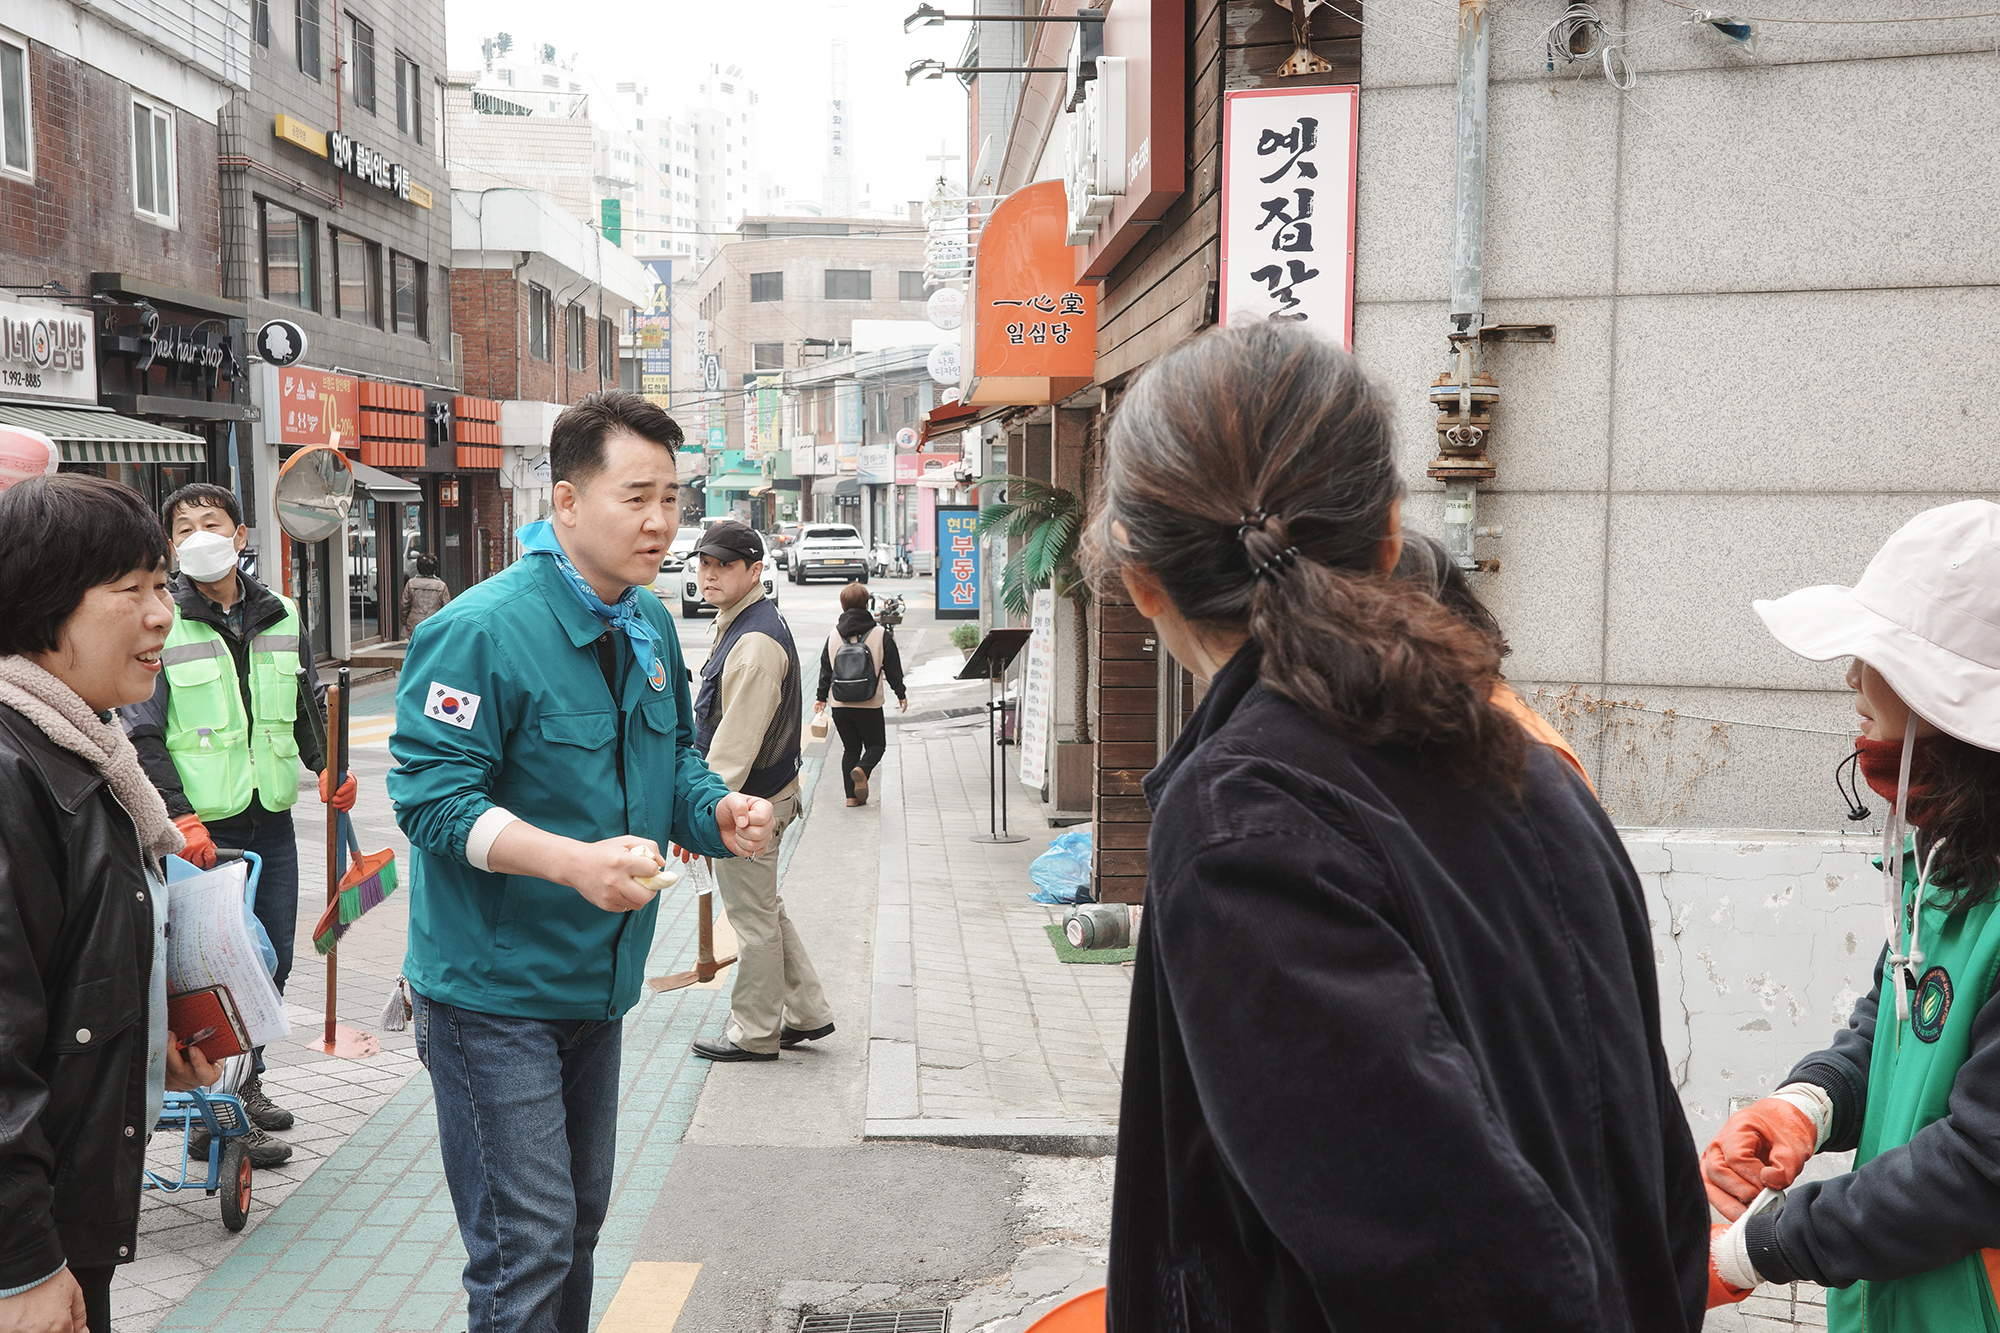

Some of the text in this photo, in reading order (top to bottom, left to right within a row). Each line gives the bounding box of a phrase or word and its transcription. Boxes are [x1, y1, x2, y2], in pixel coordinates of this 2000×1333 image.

[355, 141, 392, 191] 블라인드
[393, 164, 410, 202] 커튼
[992, 292, 1086, 315] 一心堂
[48, 318, 87, 371] 김밥
[1006, 322, 1073, 345] 일심당
[143, 312, 223, 389] Baek hair shop
[938, 357, 956, 366] 나무
[2, 370, 41, 388] T.992-8885
[935, 367, 960, 377] 디자인
[946, 517, 976, 533] 현대
[951, 535, 975, 605] 부동산
